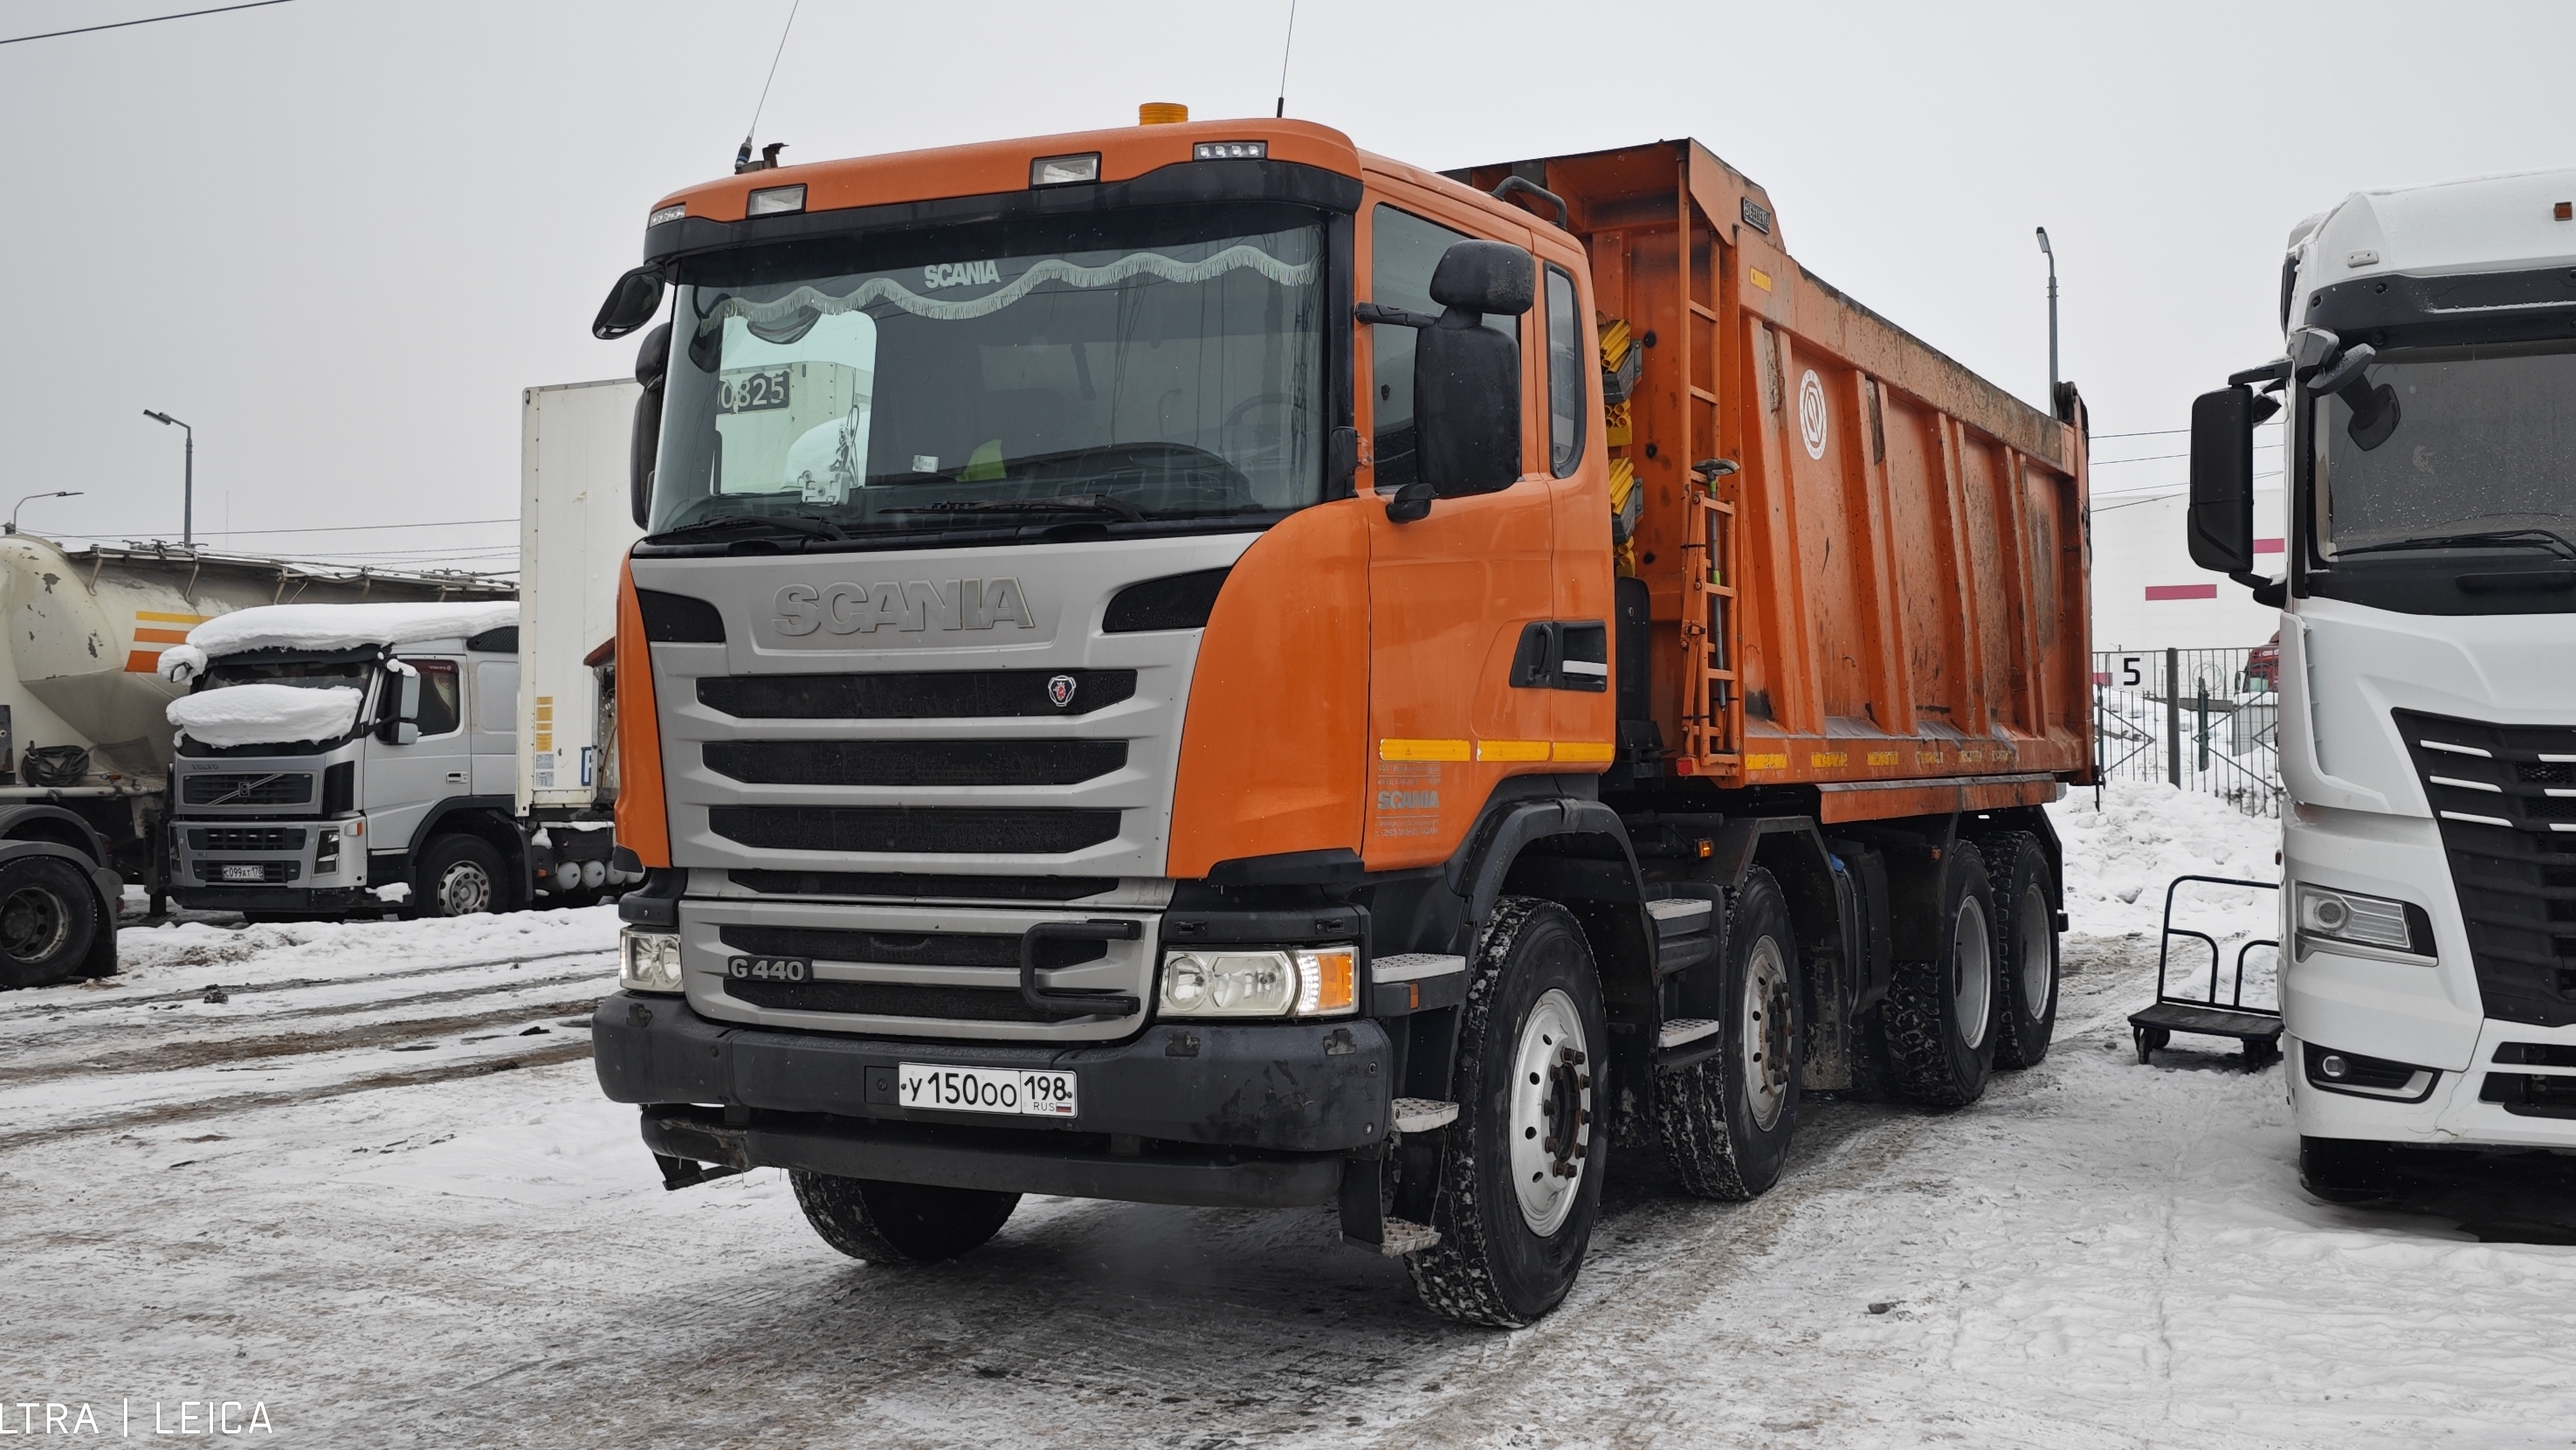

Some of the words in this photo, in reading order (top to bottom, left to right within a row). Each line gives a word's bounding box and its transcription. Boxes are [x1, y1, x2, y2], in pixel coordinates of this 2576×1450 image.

[924, 260, 1002, 289] SCANIA
[717, 376, 784, 409] 0825
[772, 577, 1035, 636] SCANIA
[2123, 658, 2141, 686] 5
[1377, 791, 1439, 810] SCANIA
[731, 958, 748, 978] G
[752, 960, 804, 981] 440
[1023, 1075, 1067, 1101] 198
[1033, 1101, 1055, 1111] RUS
